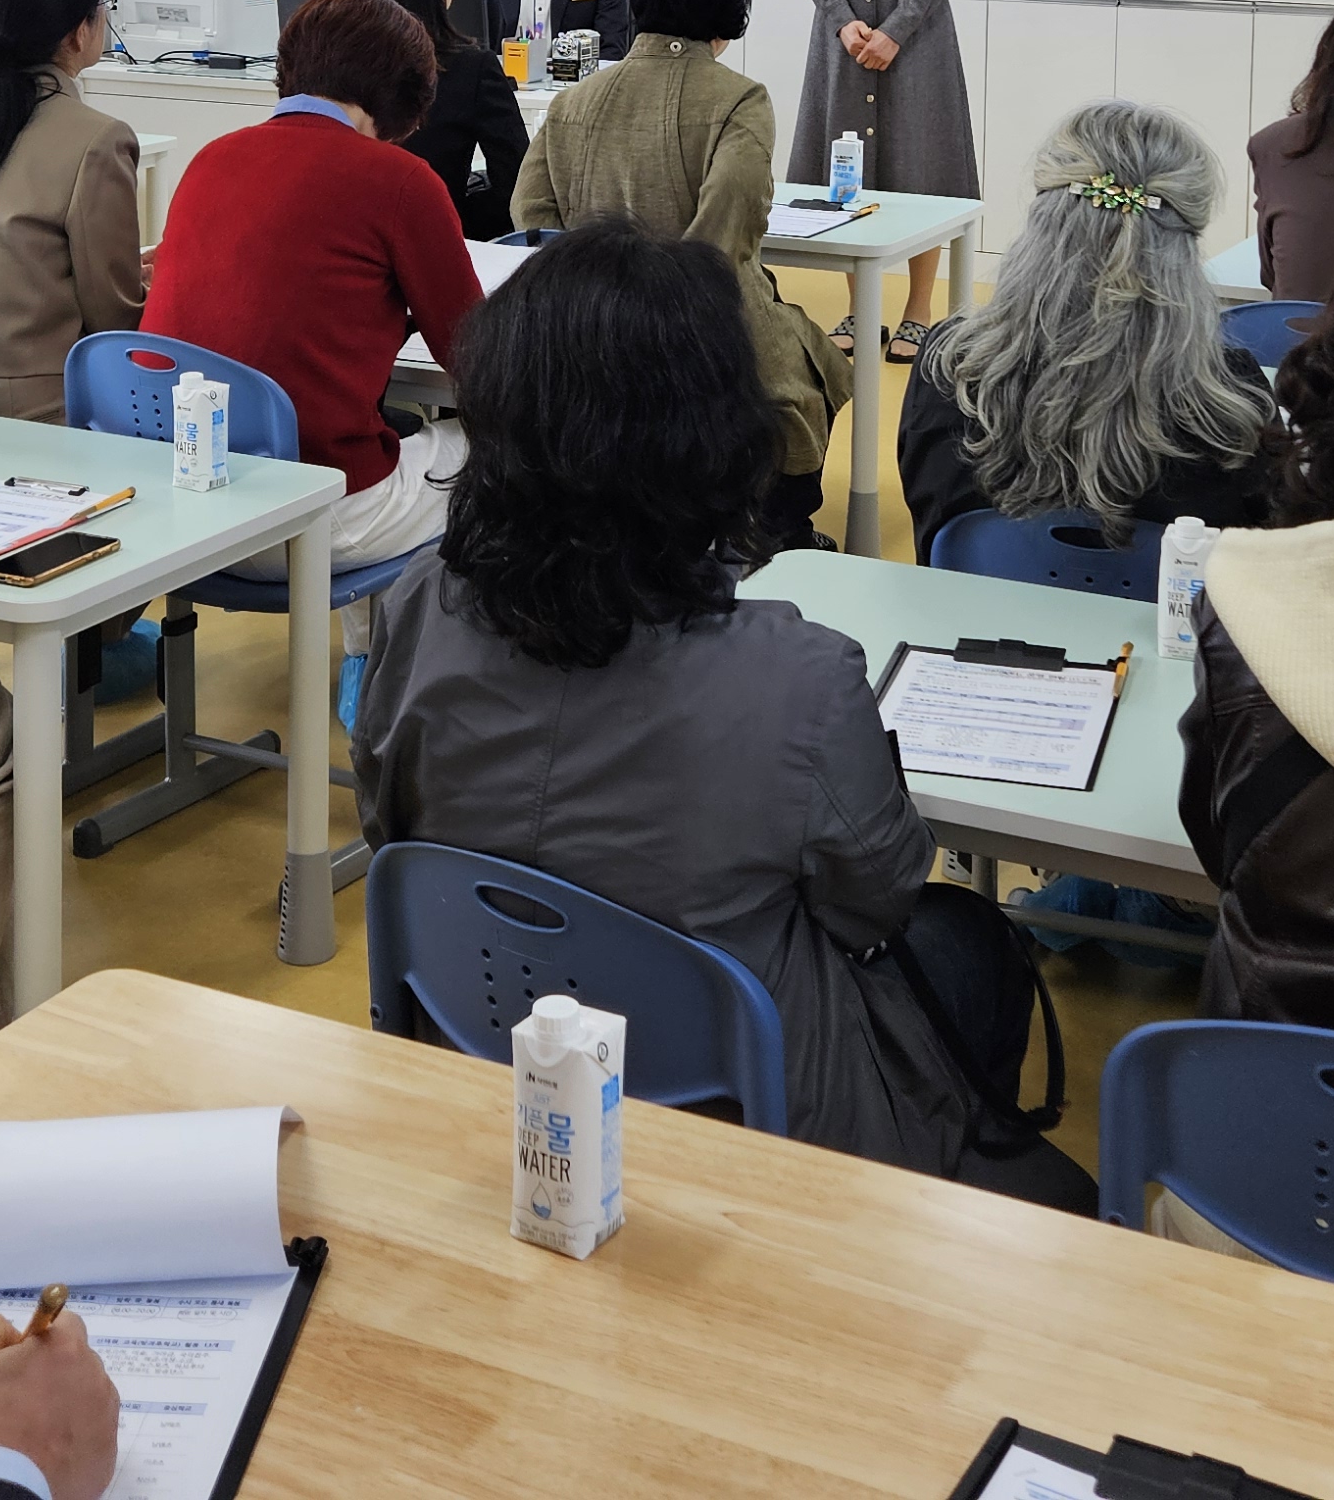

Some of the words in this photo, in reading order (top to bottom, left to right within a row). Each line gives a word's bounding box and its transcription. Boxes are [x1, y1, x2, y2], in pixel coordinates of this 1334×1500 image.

[1167, 602, 1192, 618] WAT
[517, 1125, 540, 1147] DEEP
[518, 1141, 572, 1184] WATER
